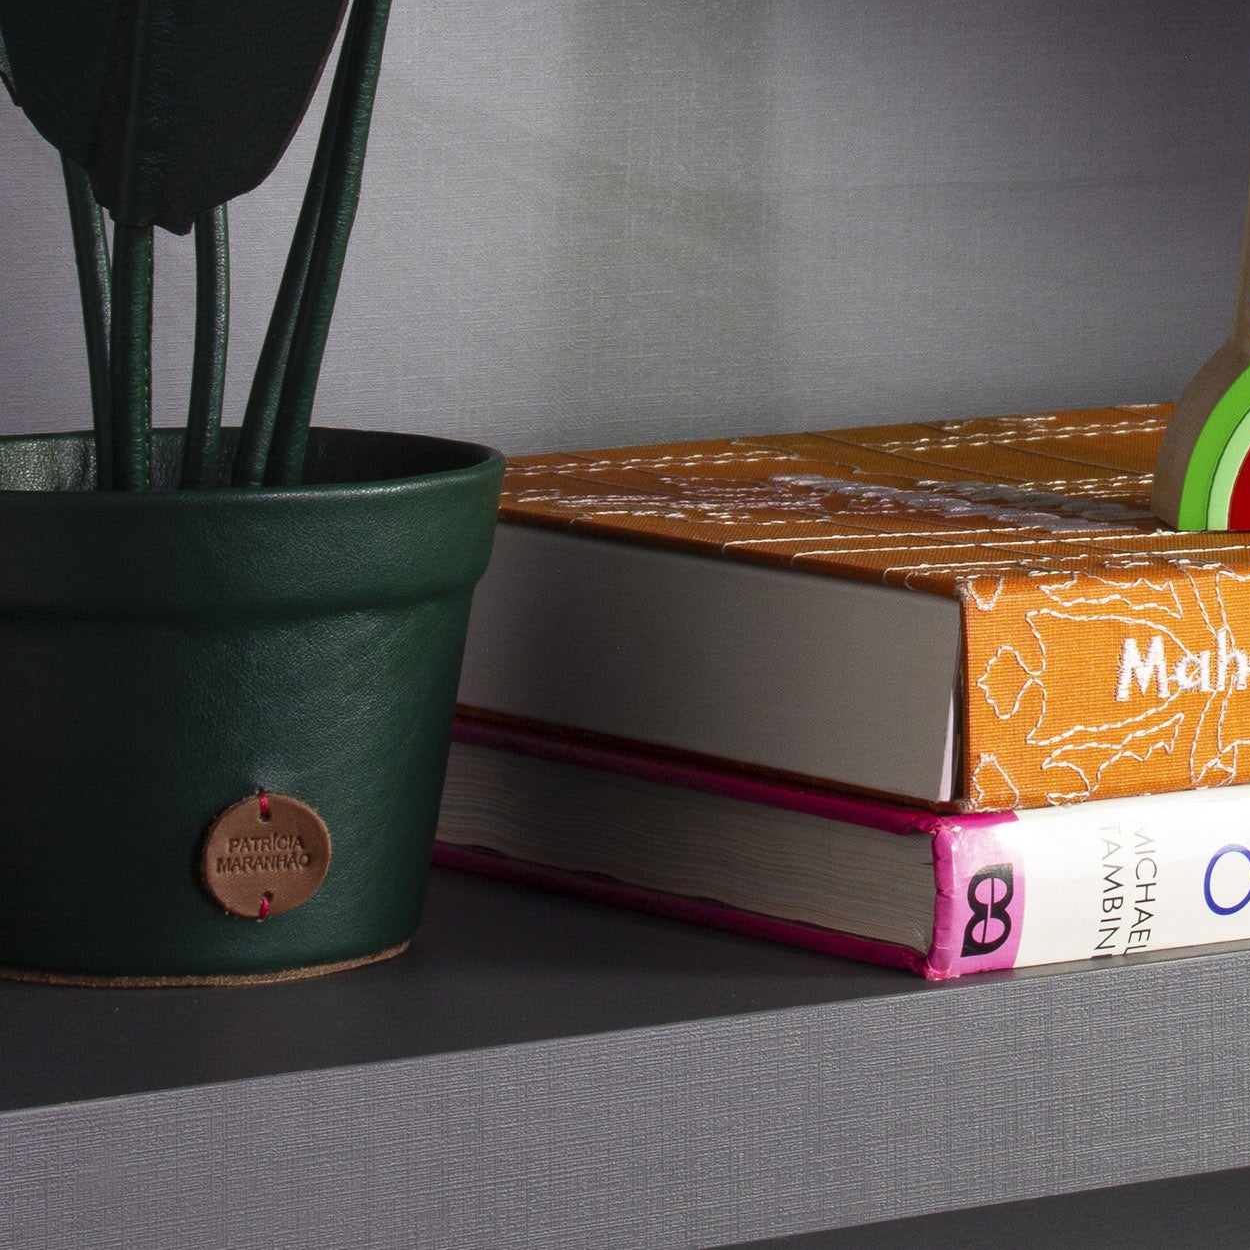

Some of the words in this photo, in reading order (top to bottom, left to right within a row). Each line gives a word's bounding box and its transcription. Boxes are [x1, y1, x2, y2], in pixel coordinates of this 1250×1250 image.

[228, 832, 305, 853] PATRÍCIA
[215, 851, 312, 874] MARANHÃO
[1121, 822, 1158, 956] MICHAEL
